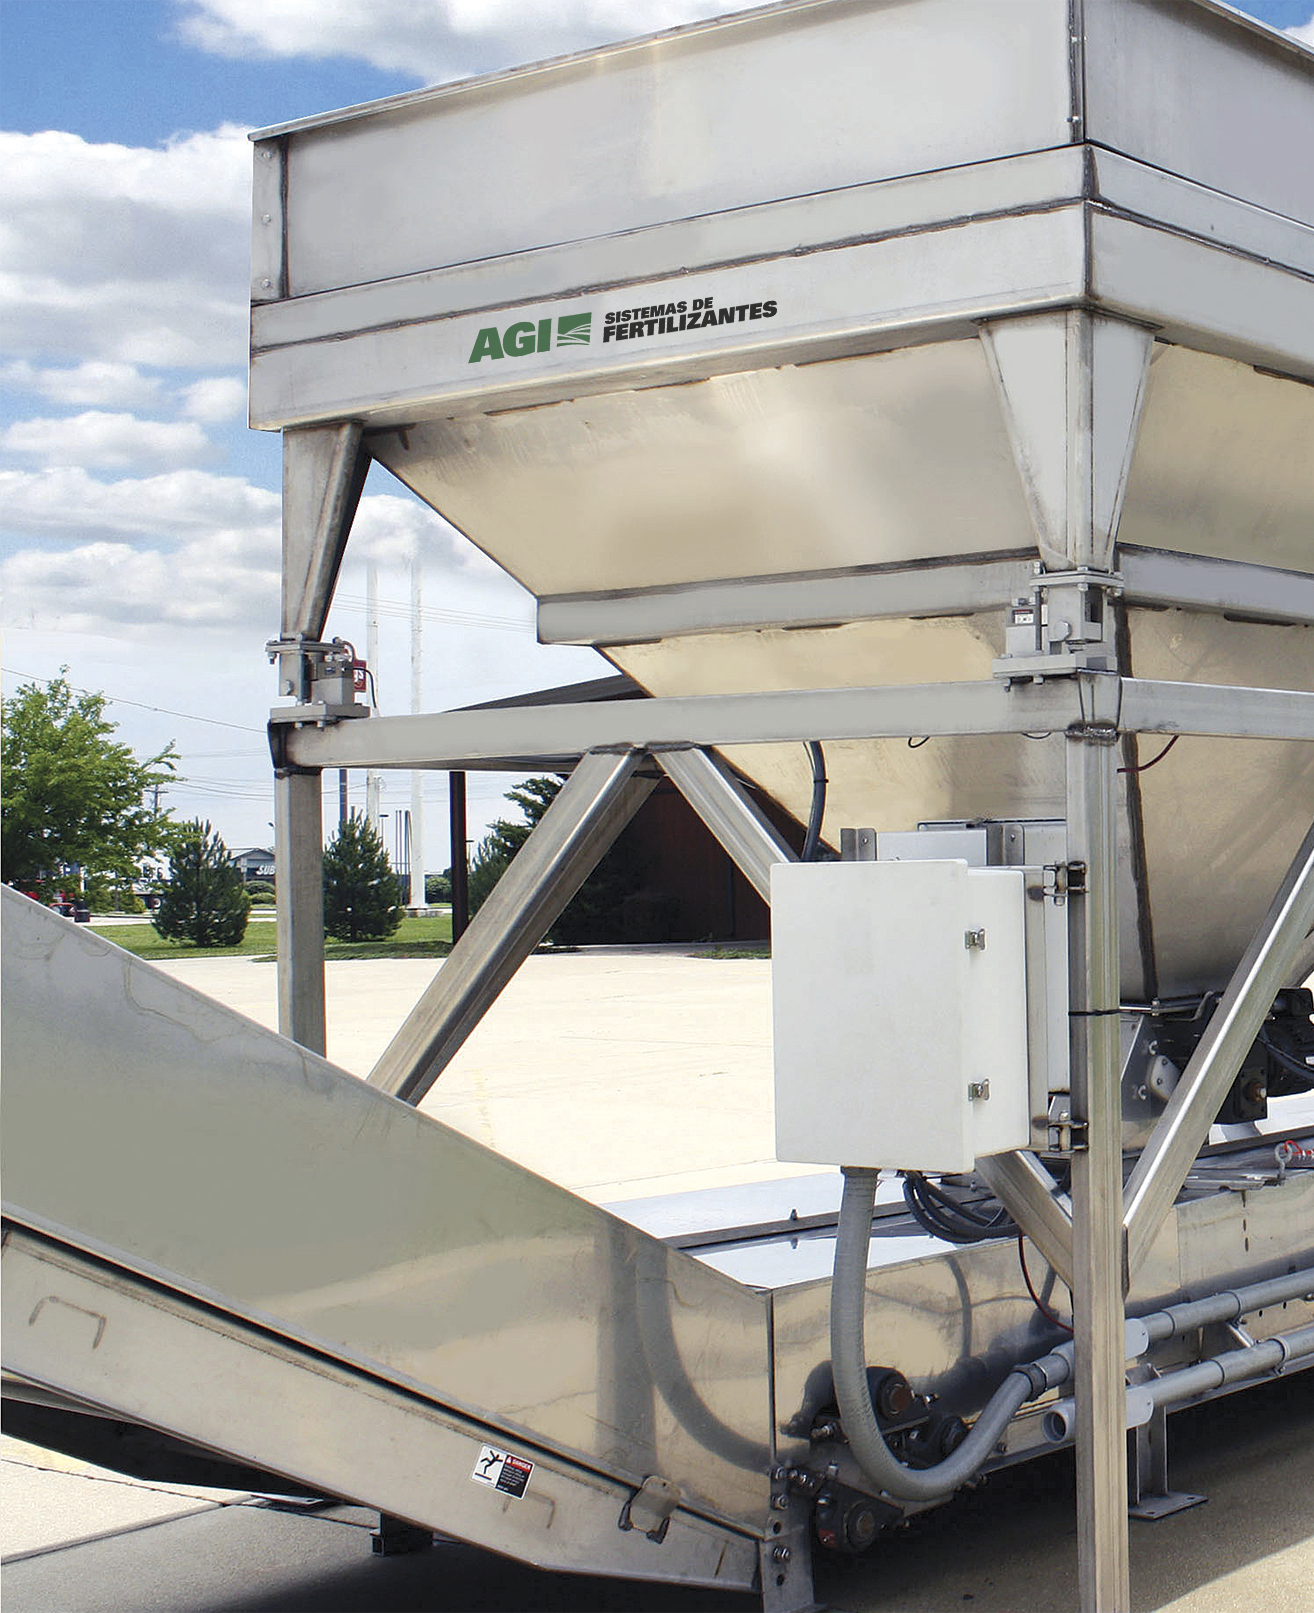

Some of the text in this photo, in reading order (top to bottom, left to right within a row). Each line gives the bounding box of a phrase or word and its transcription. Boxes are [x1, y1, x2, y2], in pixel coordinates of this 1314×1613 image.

[603, 301, 777, 342] FERTILIZANTES
[605, 297, 713, 324] SISTEMAS DE
[468, 319, 552, 363] AGI
